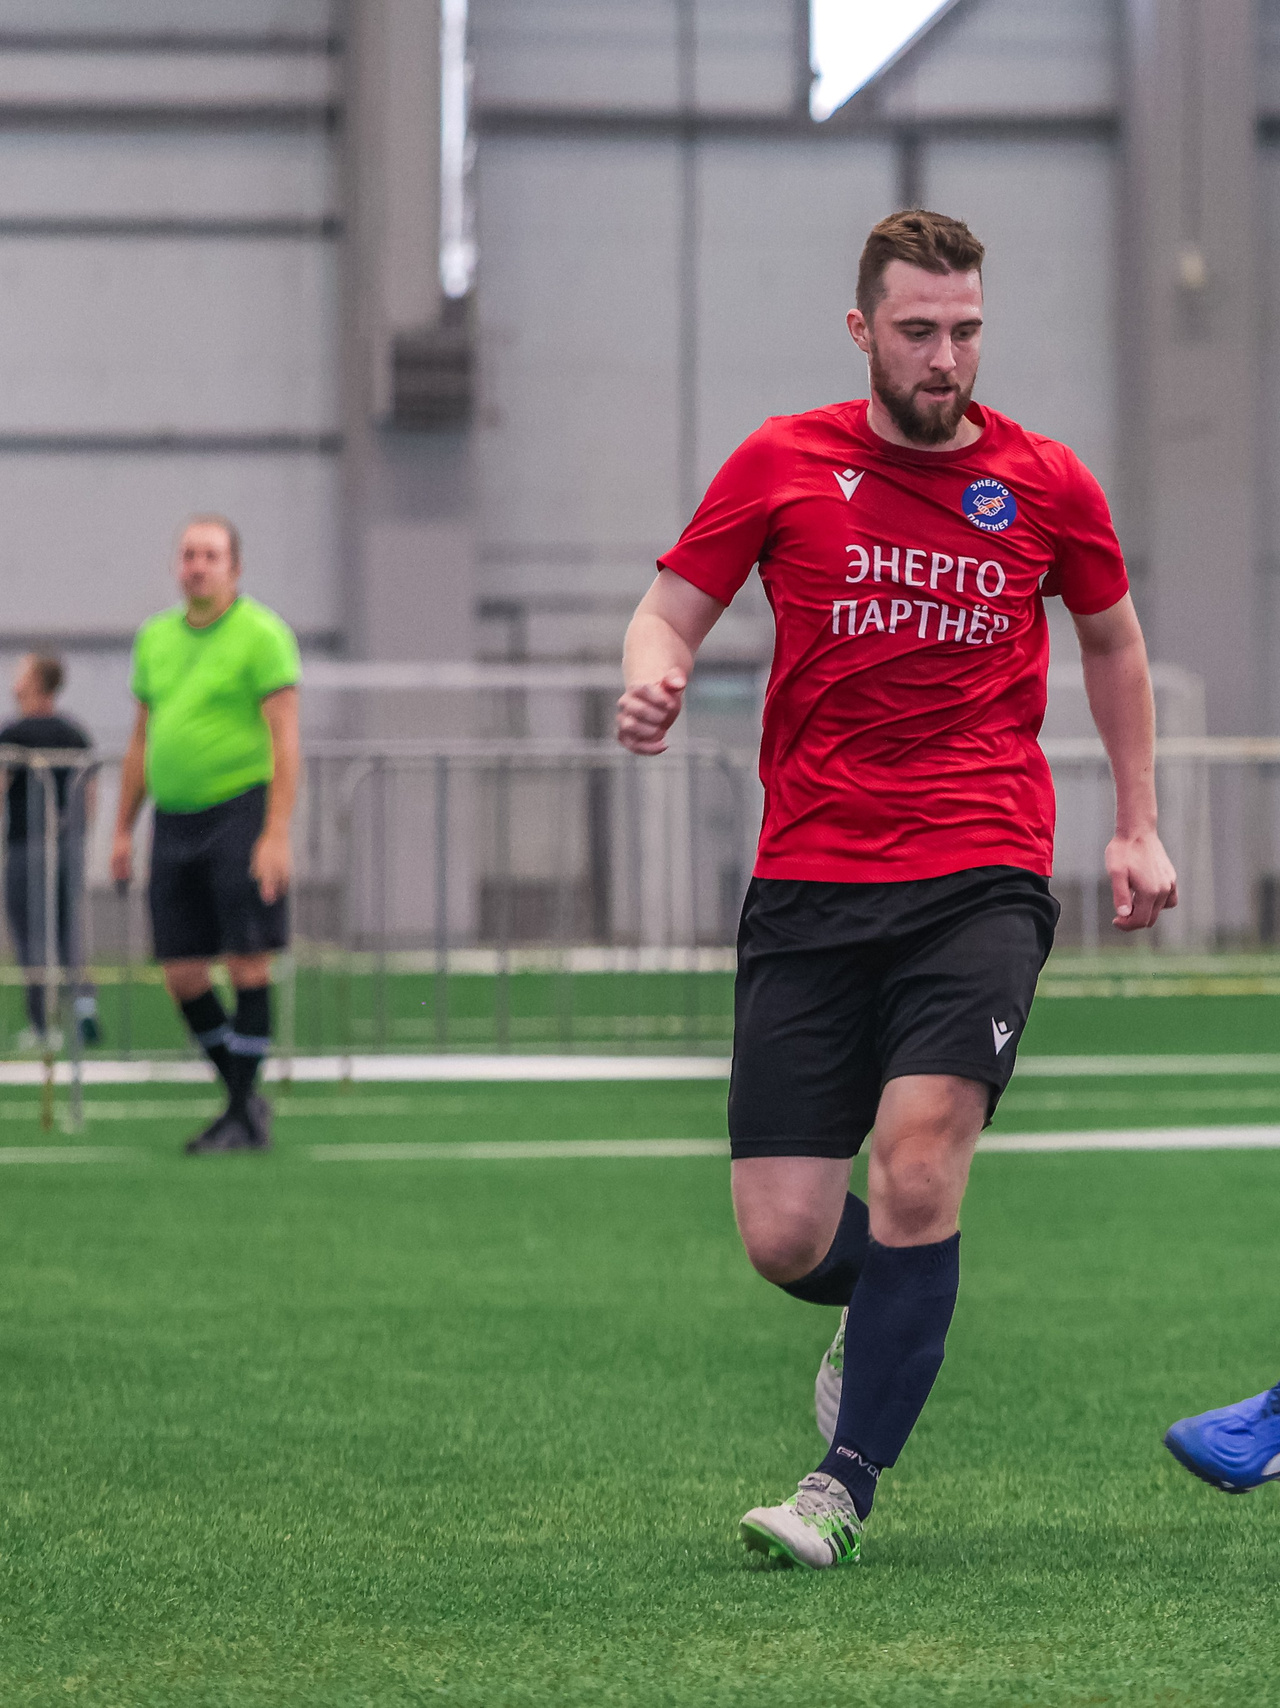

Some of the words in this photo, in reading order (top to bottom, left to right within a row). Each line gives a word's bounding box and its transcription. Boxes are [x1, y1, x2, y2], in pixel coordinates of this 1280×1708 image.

[970, 479, 1009, 496] ЭНЕРГО
[967, 513, 1009, 531] ПАРТНЕР
[845, 544, 1007, 598] ЭНЕРГО
[831, 599, 1010, 645] ПАРТНЁР
